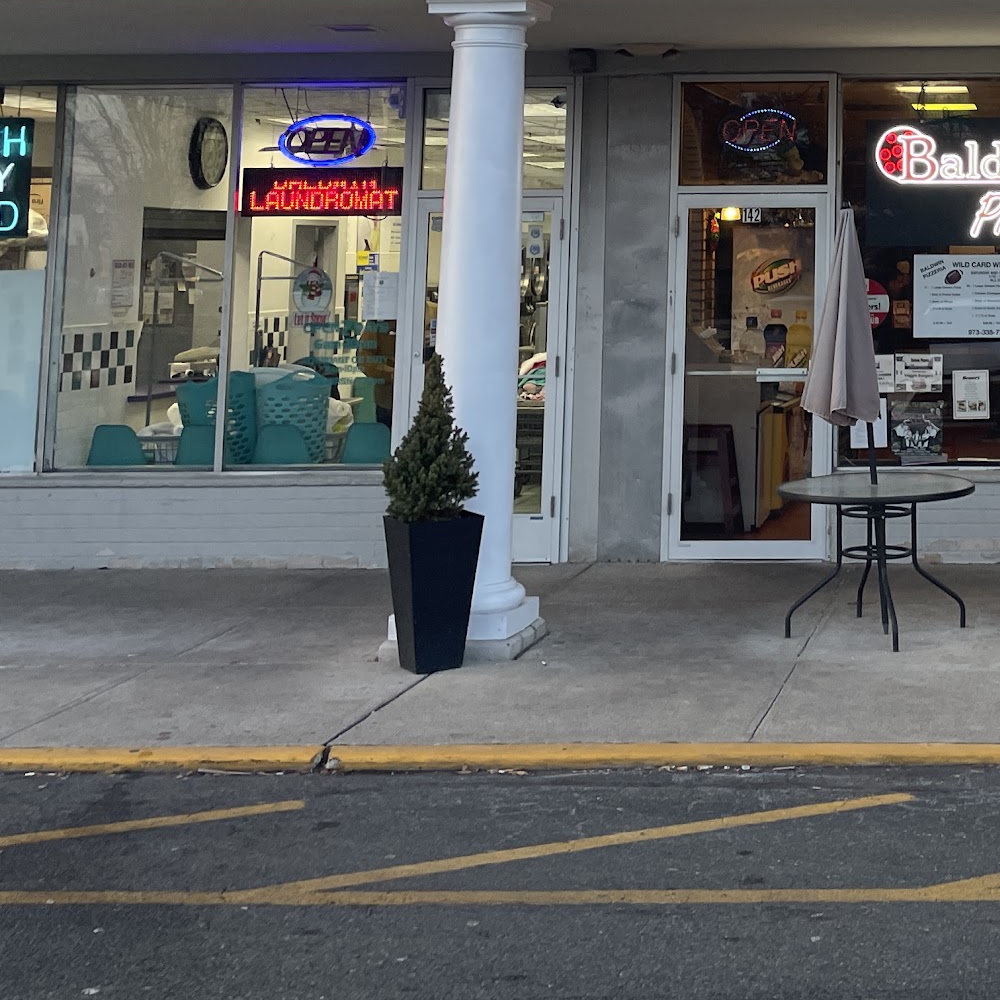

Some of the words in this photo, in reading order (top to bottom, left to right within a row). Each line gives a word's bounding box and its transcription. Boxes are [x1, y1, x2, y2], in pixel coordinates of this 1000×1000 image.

[286, 122, 371, 157] OPEN
[722, 118, 797, 143] OPEN
[249, 190, 399, 210] LAUNDROMAT
[744, 208, 760, 221] 142
[752, 260, 801, 289] PUSH
[919, 259, 945, 274] BALDWIN
[922, 265, 947, 280] PIZZERIA
